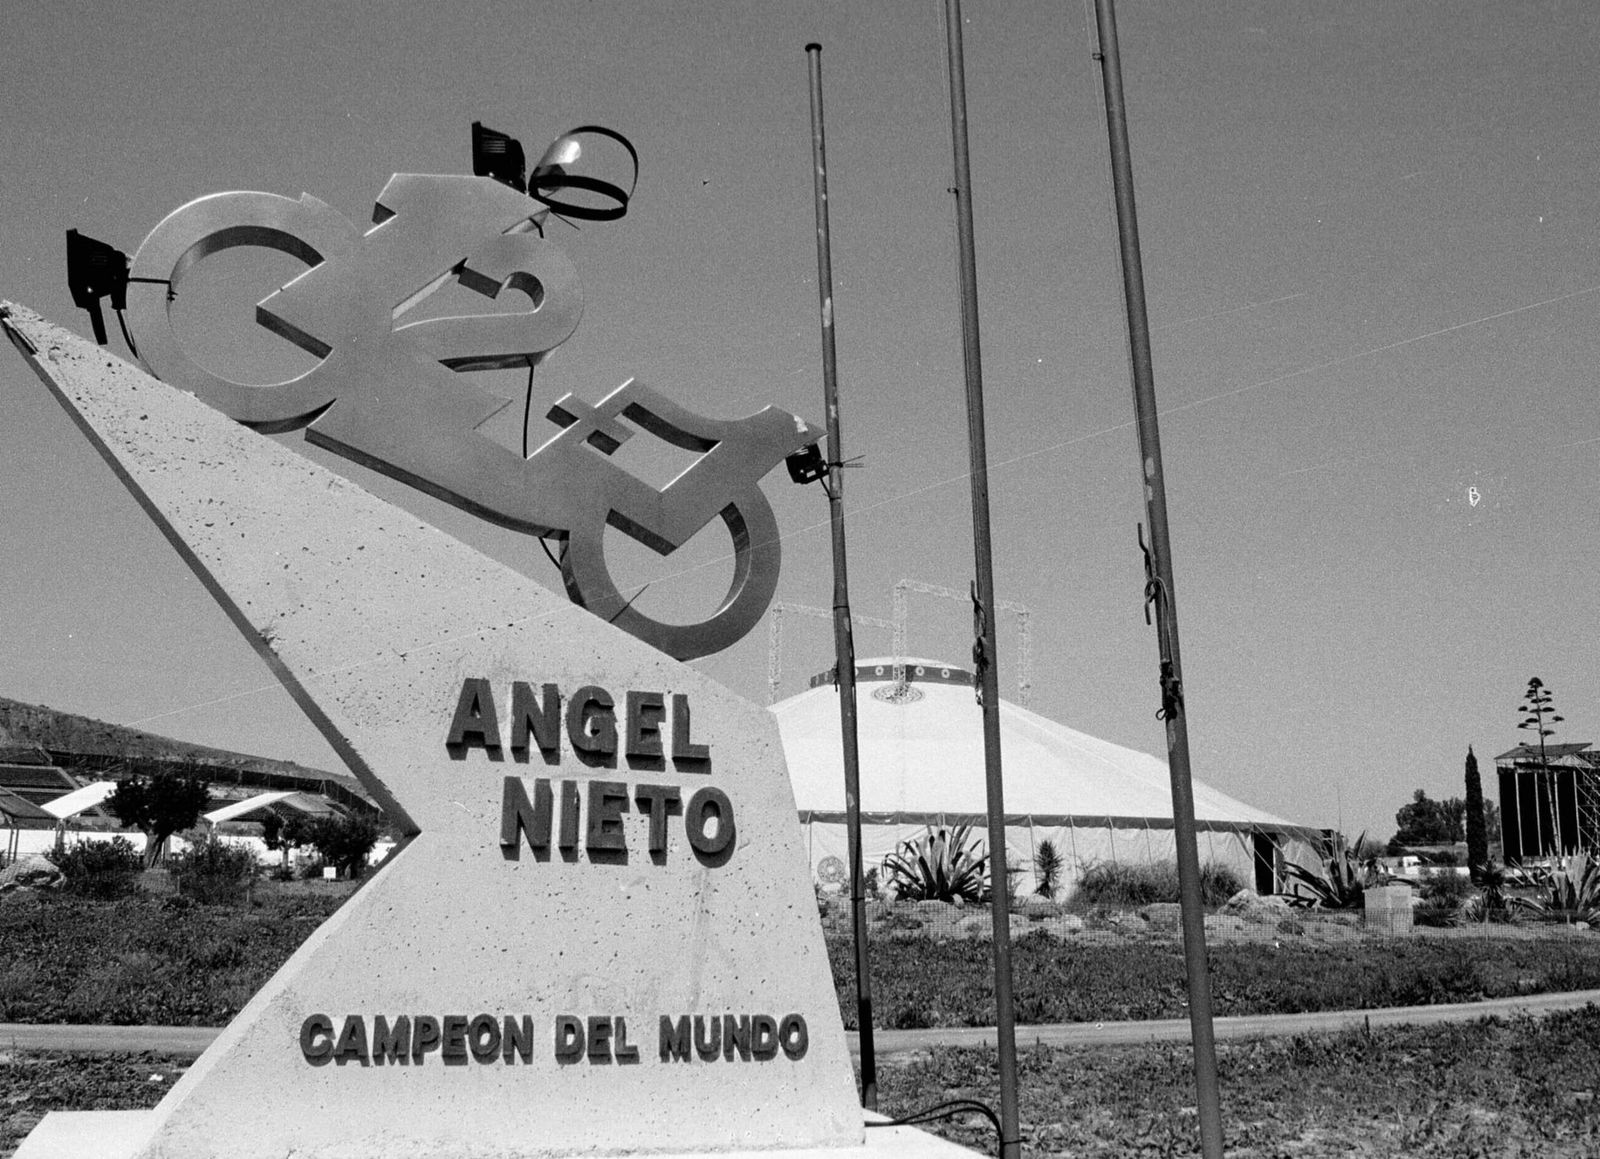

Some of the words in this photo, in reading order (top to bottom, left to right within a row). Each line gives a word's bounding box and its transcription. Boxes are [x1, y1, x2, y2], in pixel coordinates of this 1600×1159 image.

[446, 678, 711, 774] ANGEL
[500, 776, 736, 868] NIETO
[300, 1014, 534, 1067] CAMPEON
[555, 1014, 639, 1065] DEL
[660, 1013, 808, 1064] MUNDO
